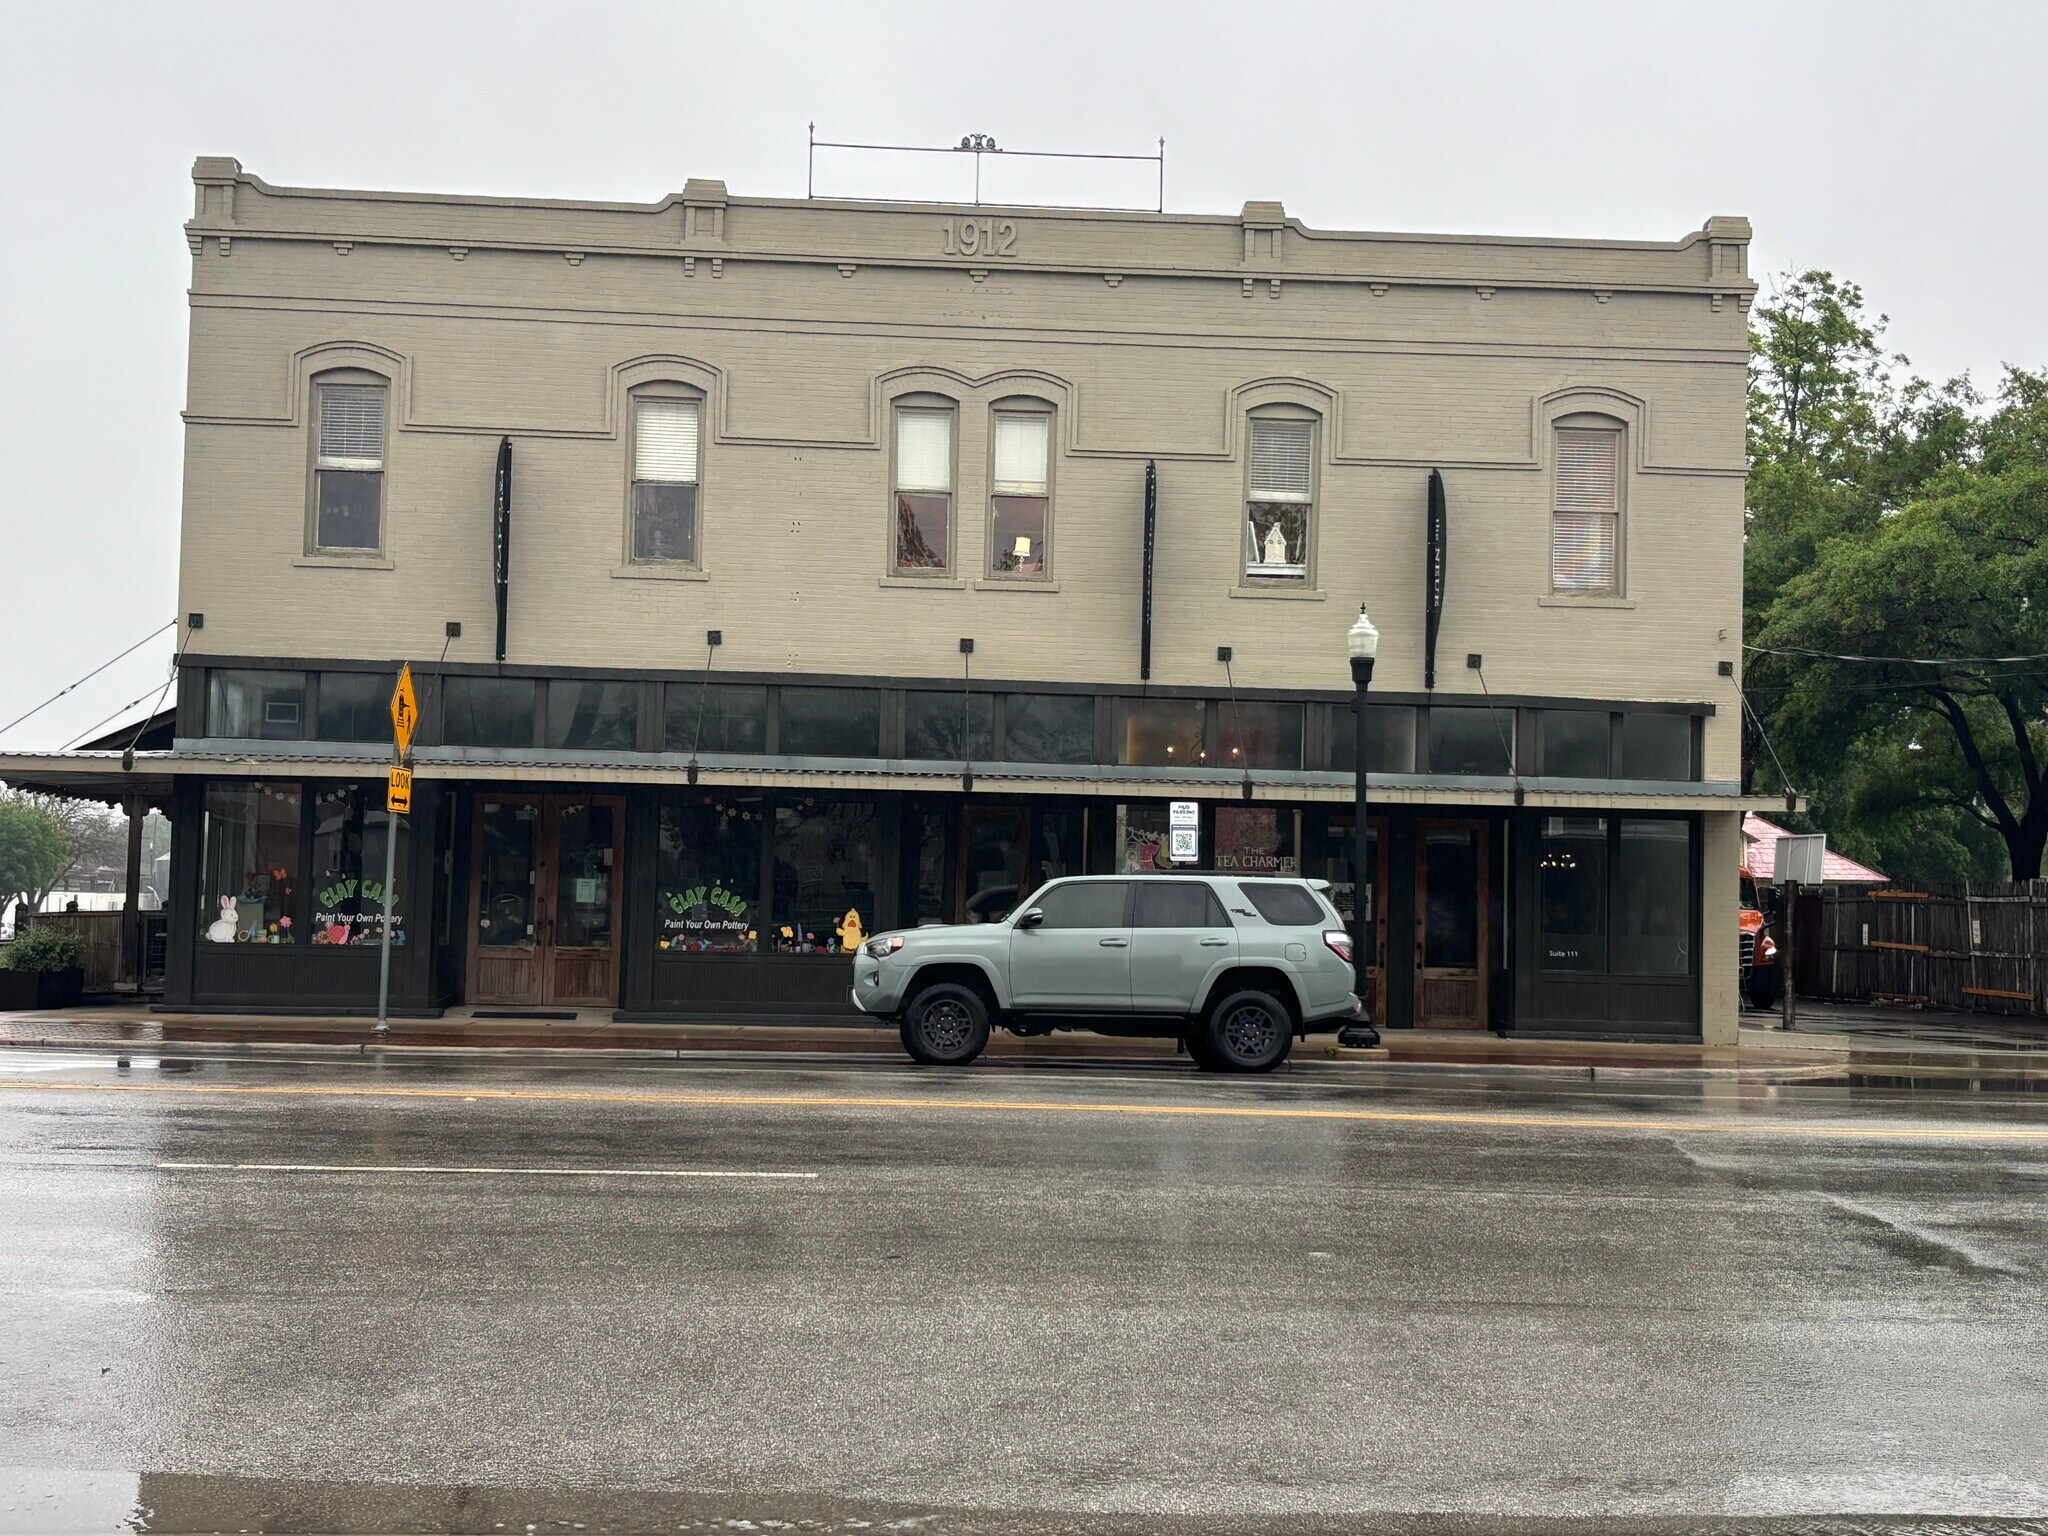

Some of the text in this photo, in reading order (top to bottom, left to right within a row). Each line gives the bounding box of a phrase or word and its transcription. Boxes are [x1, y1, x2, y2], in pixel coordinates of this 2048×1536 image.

[942, 218, 1017, 257] 1912
[391, 771, 410, 790] LOOK
[1243, 846, 1266, 855] THE
[1215, 855, 1297, 868] TEA CHARMER
[319, 879, 358, 908] CLAY
[669, 886, 747, 917] CLAY CASA
[315, 912, 403, 925] Paint Your Own Poery
[664, 919, 749, 932] Paint Your Own Pottery
